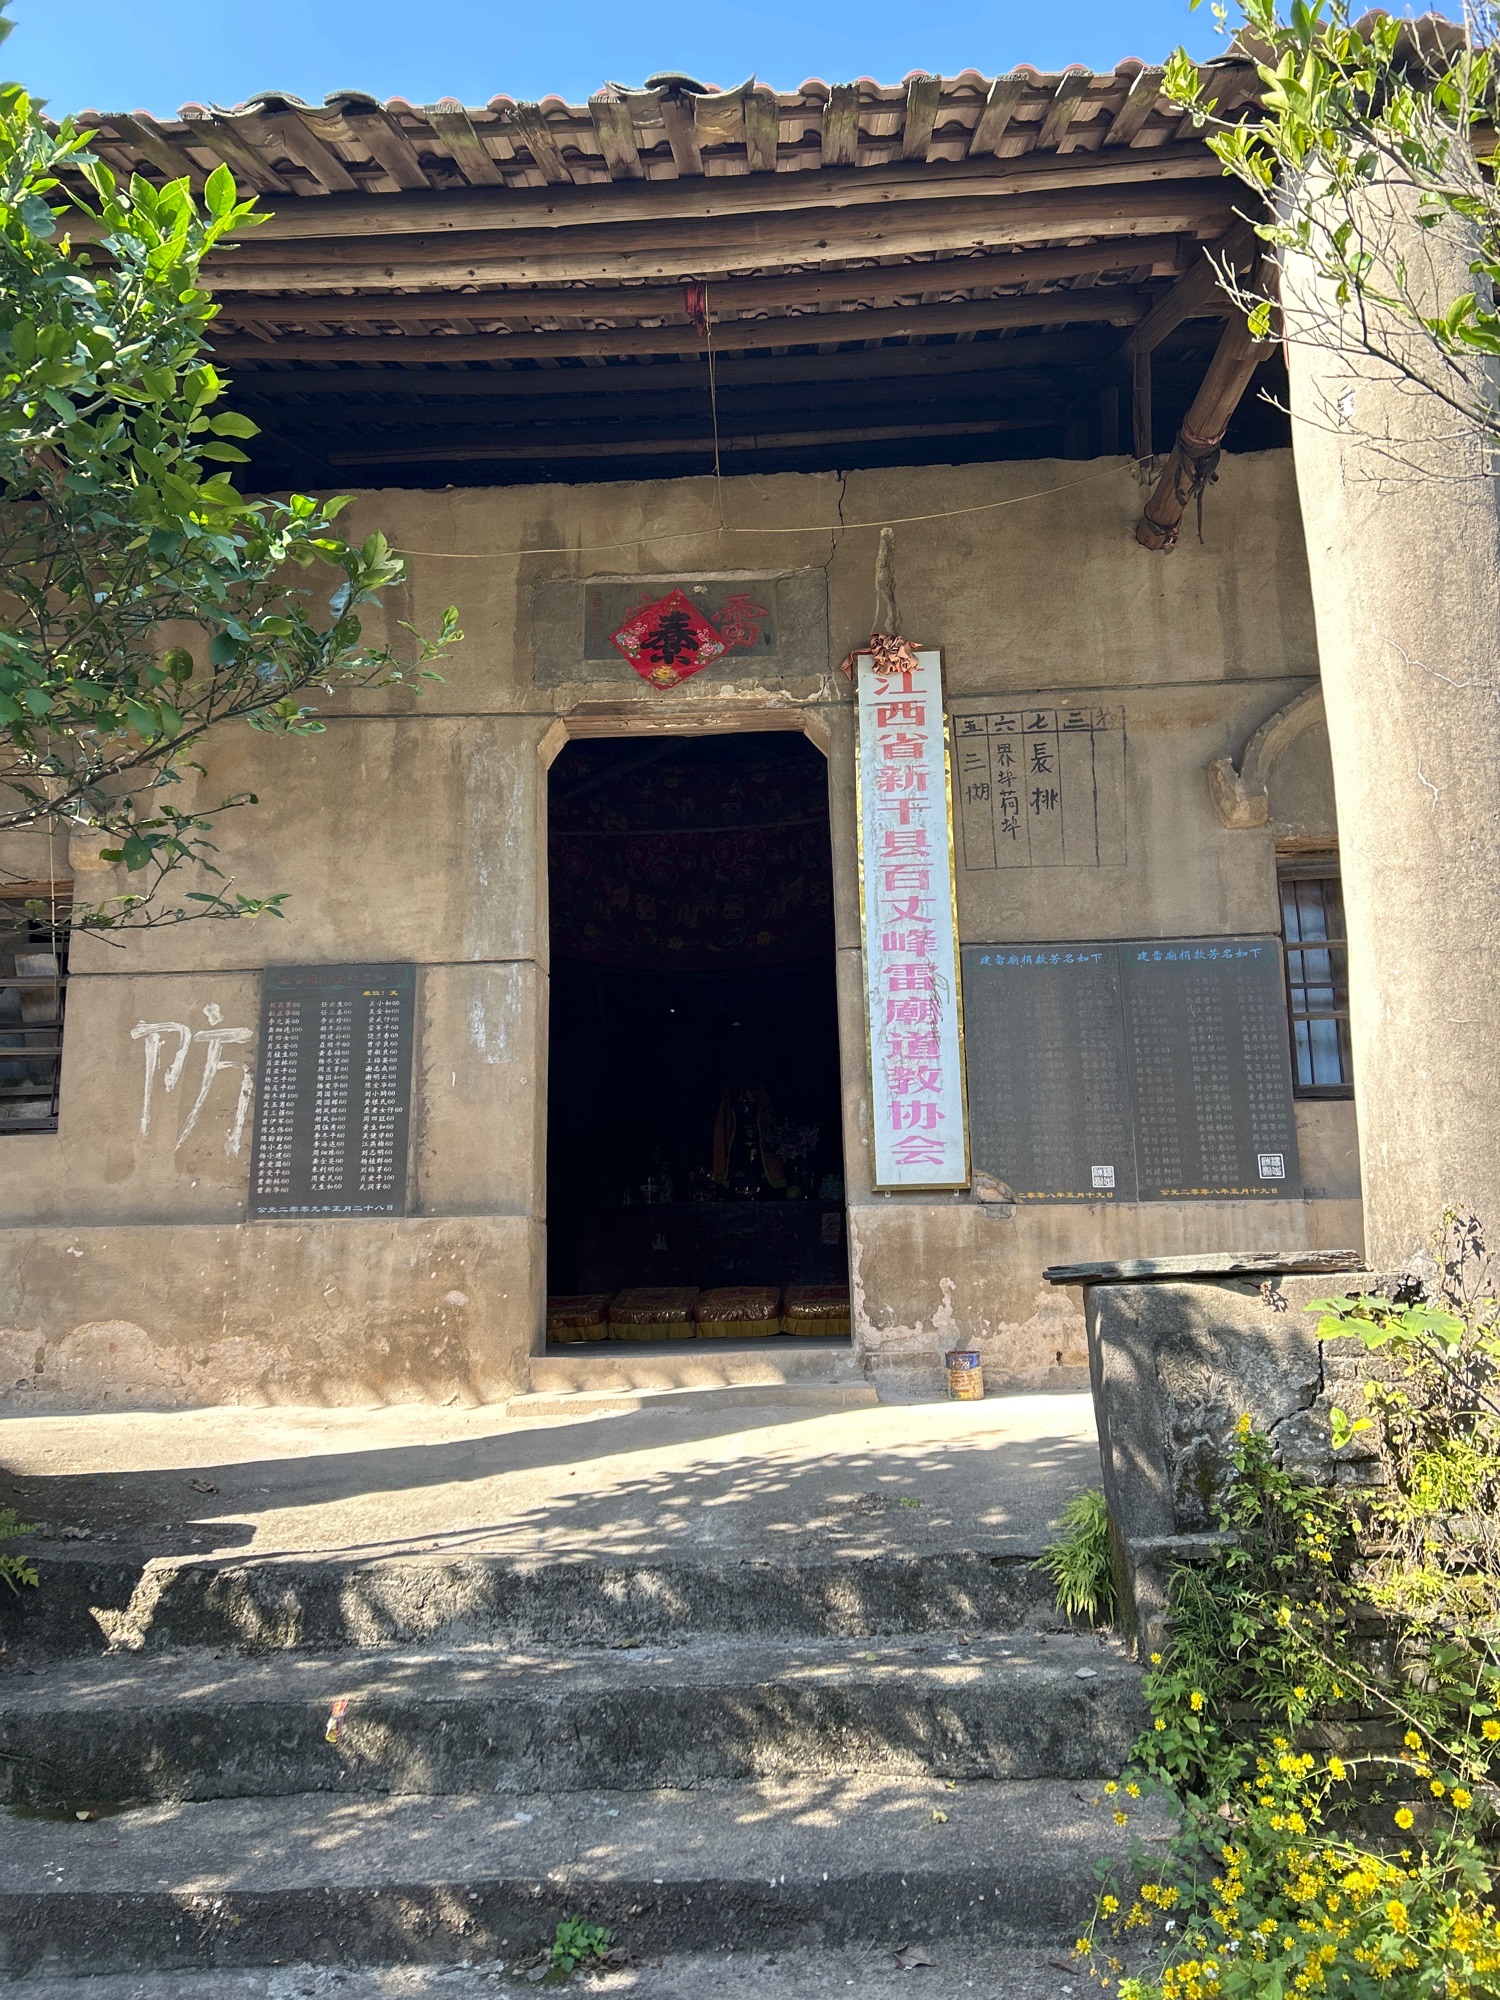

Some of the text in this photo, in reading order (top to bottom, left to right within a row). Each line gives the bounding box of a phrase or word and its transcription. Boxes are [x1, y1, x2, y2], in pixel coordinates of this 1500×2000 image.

[994, 715, 1015, 732] 六
[1027, 714, 1048, 729] 七
[1063, 710, 1092, 729] 三
[1160, 1188, 1278, 1196] 公元二零零八年五月十九日
[257, 1204, 393, 1213] 公元二零零九年正月二十八日
